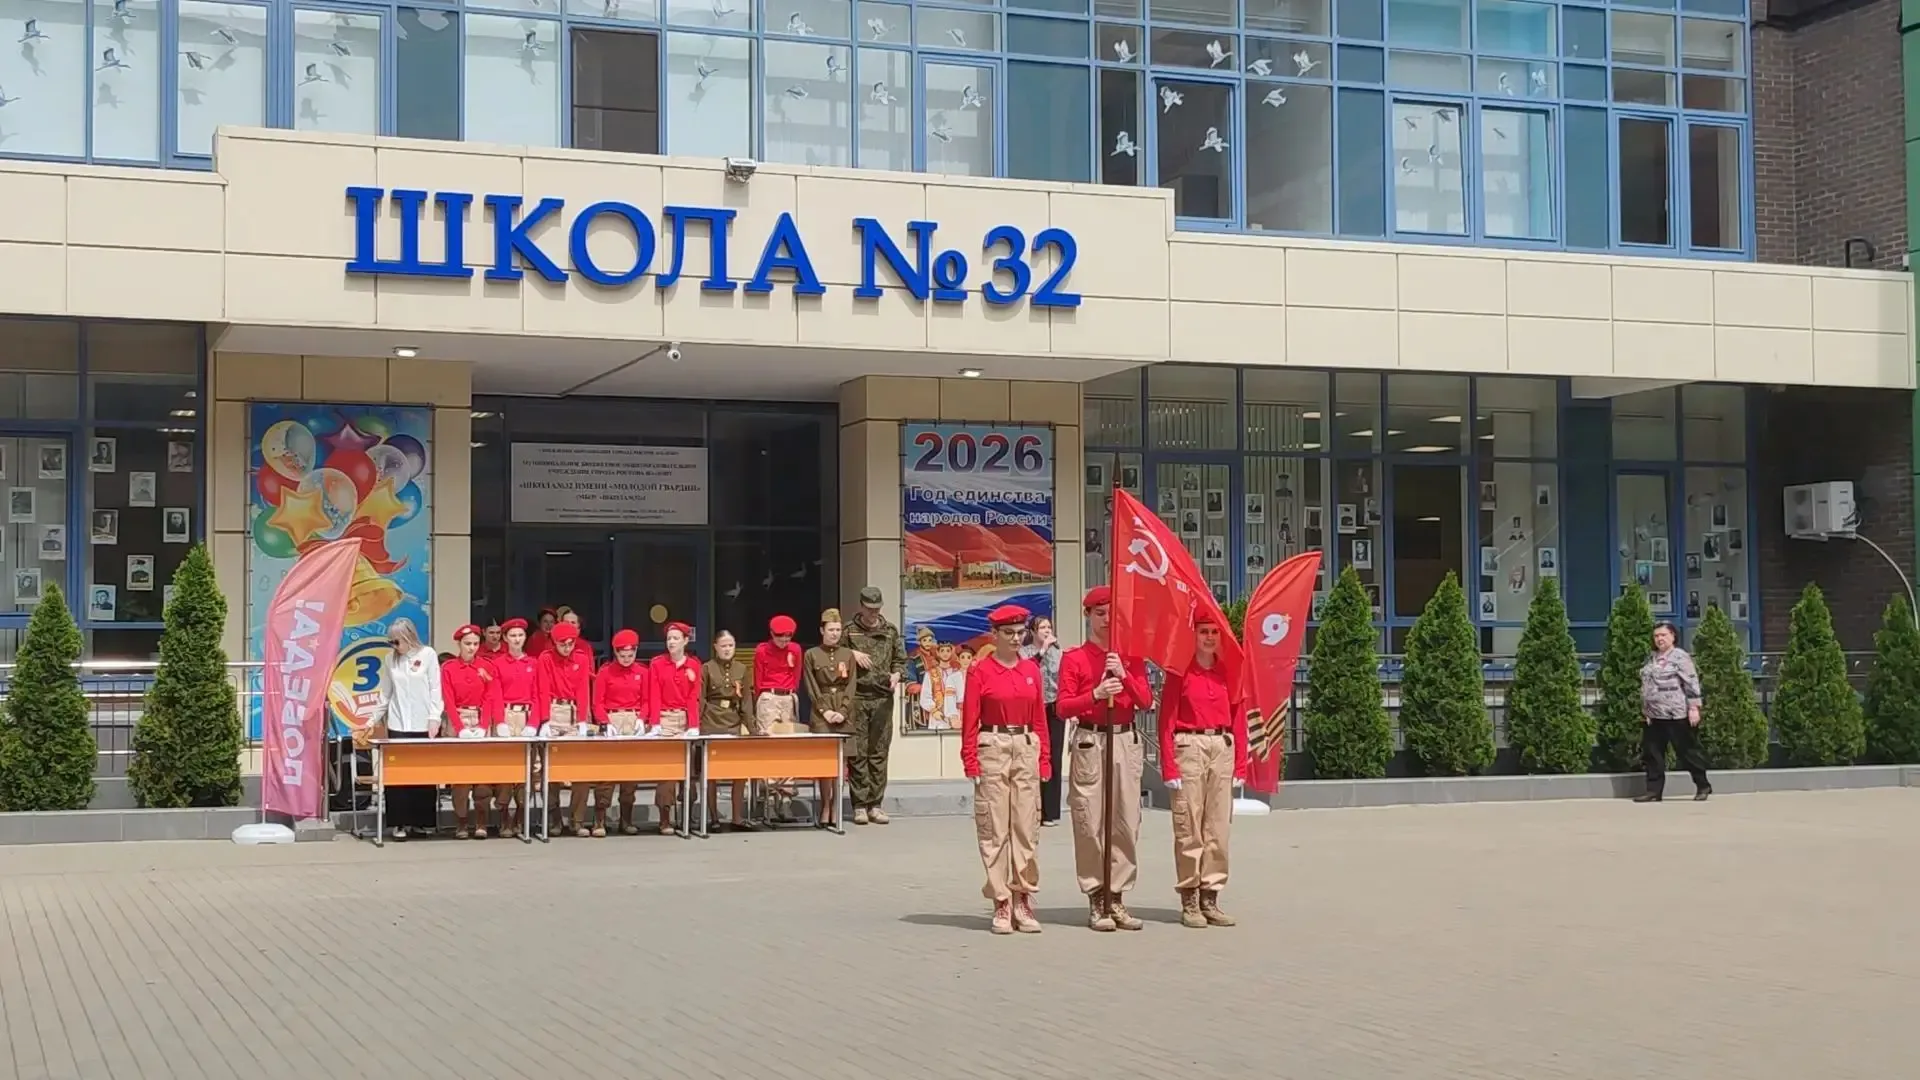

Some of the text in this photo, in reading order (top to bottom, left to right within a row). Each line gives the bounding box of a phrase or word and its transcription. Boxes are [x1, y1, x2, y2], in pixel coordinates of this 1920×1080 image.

[345, 186, 826, 295] ШКОЛА
[914, 432, 1044, 475] 2026
[910, 485, 1047, 506] Год единства
[909, 510, 1049, 527] народов России
